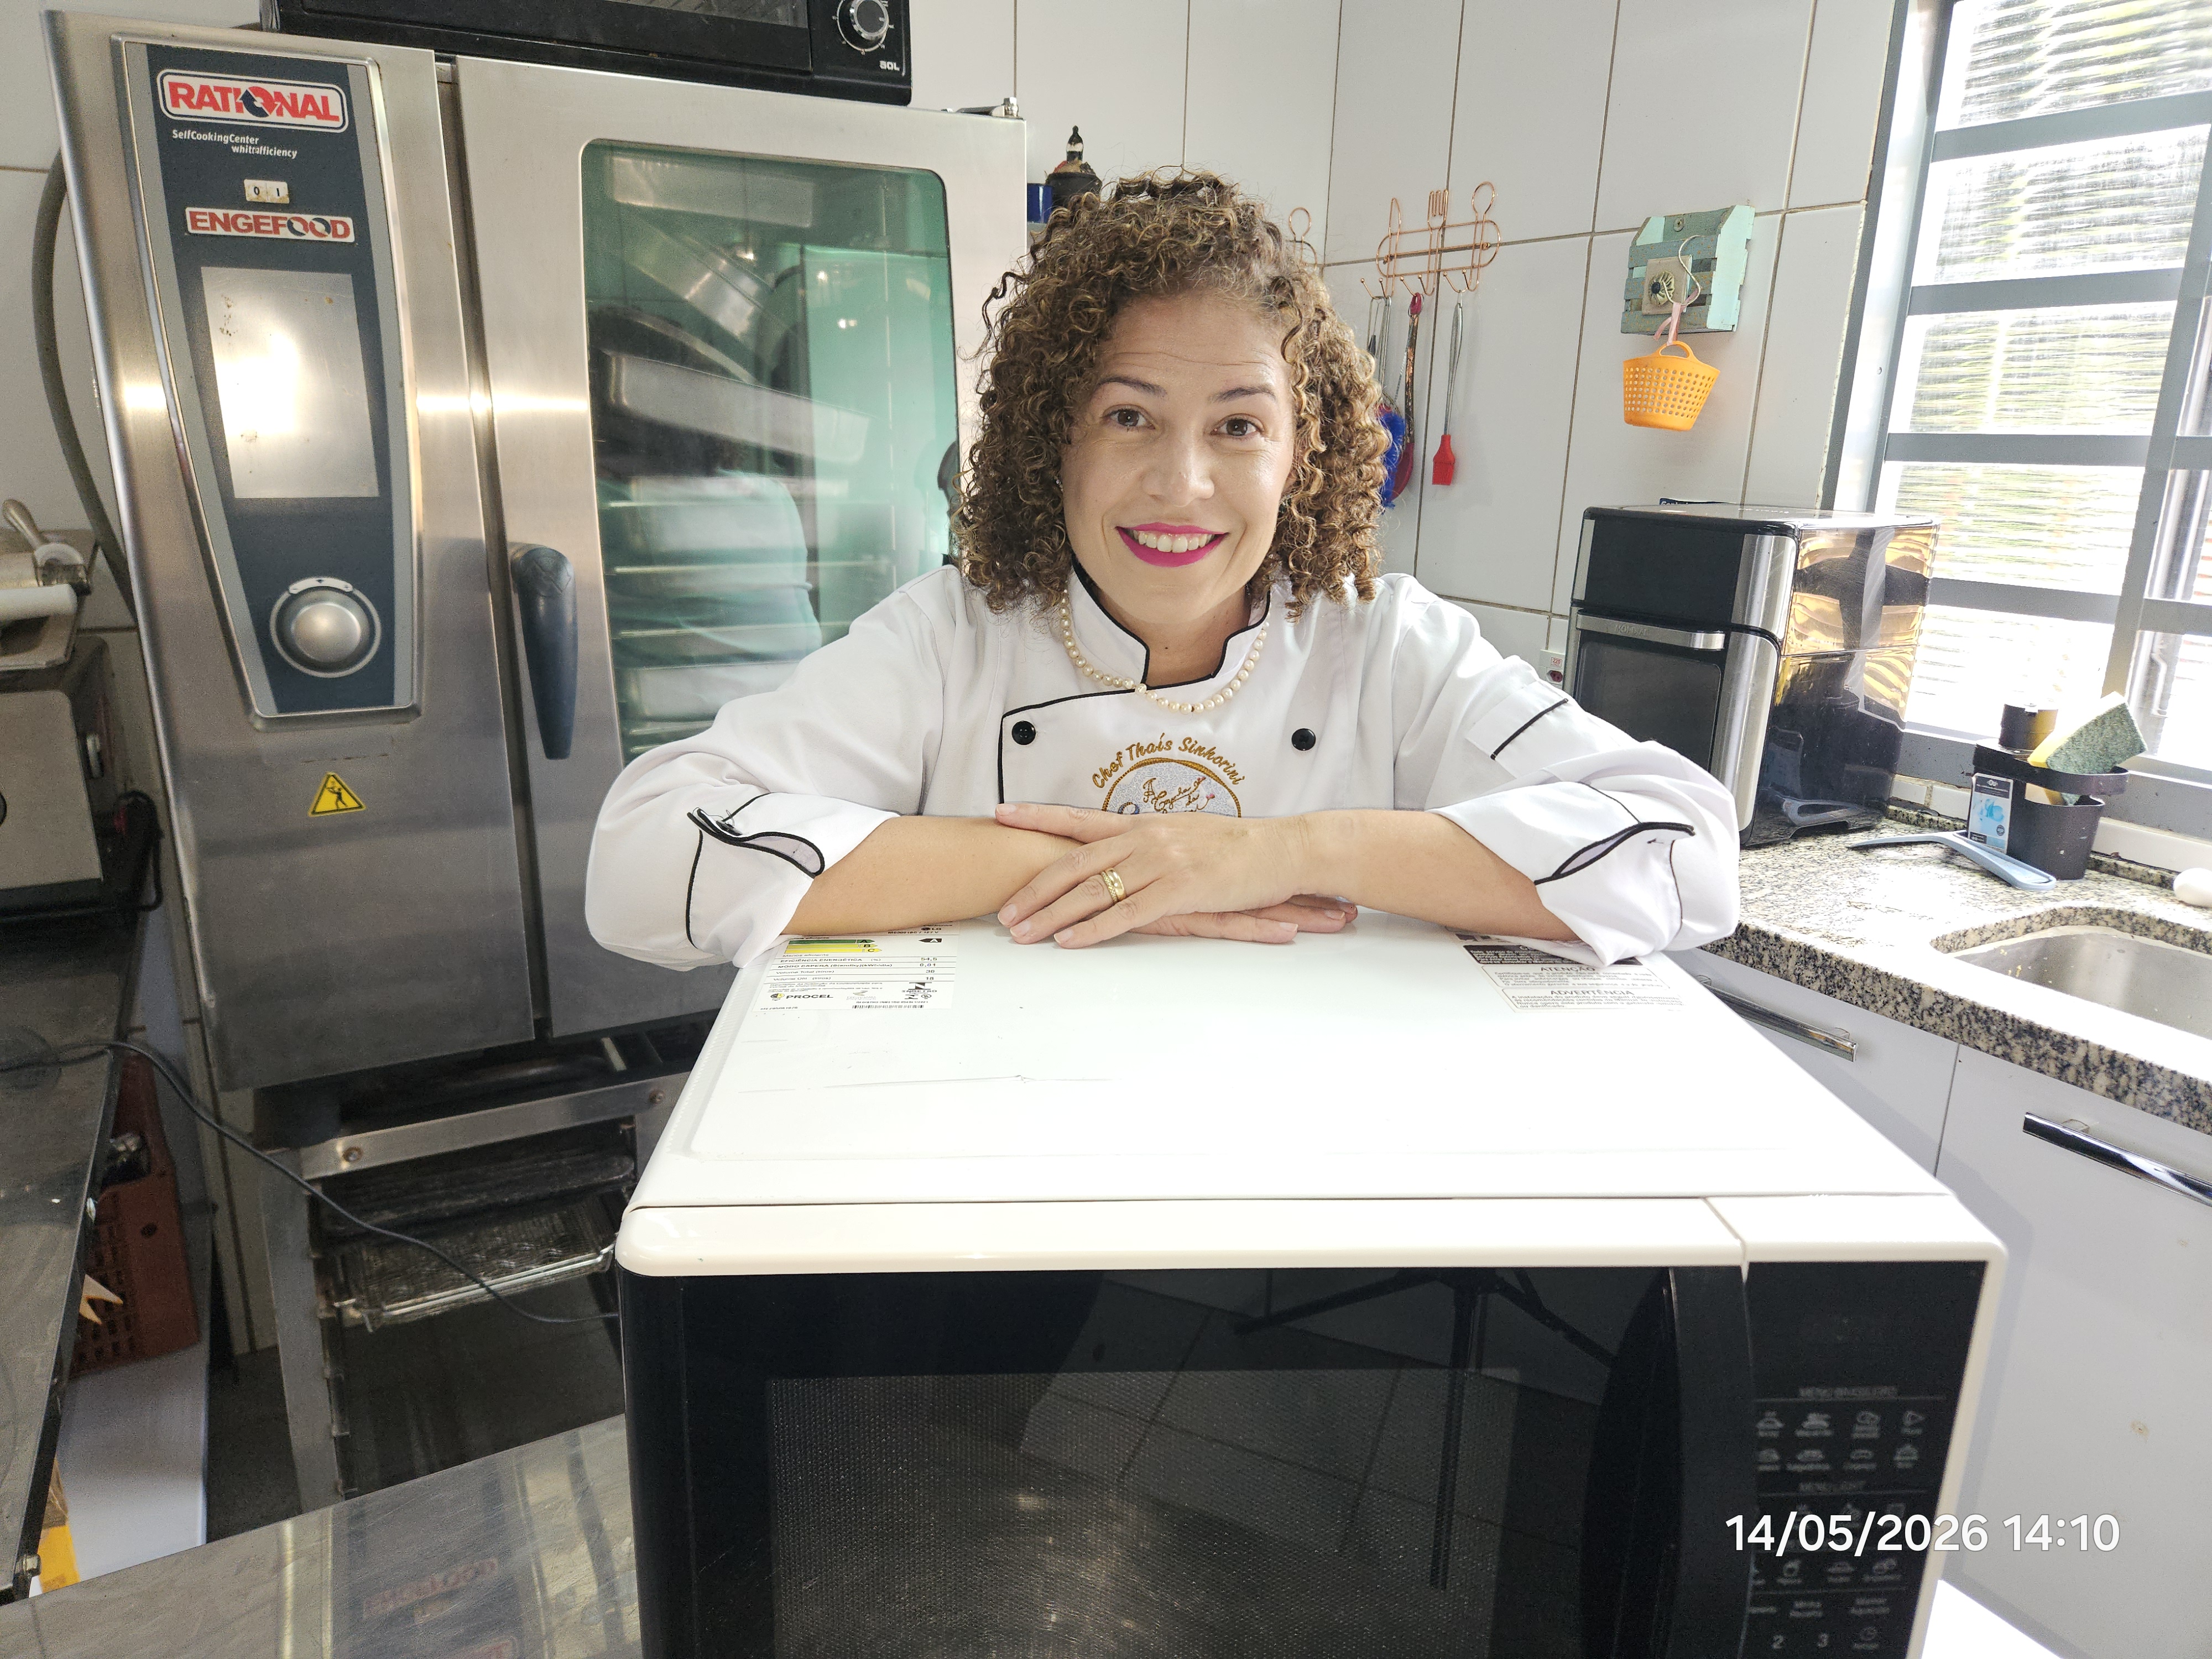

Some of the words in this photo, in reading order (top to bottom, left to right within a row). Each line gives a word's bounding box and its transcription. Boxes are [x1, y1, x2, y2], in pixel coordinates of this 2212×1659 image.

[168, 81, 340, 122] RATIONAL
[172, 129, 259, 144] SelfCookingCenter
[189, 211, 351, 239] ENGEFOOD
[1092, 751, 1123, 788] Chef
[1125, 732, 1173, 761] Thaís
